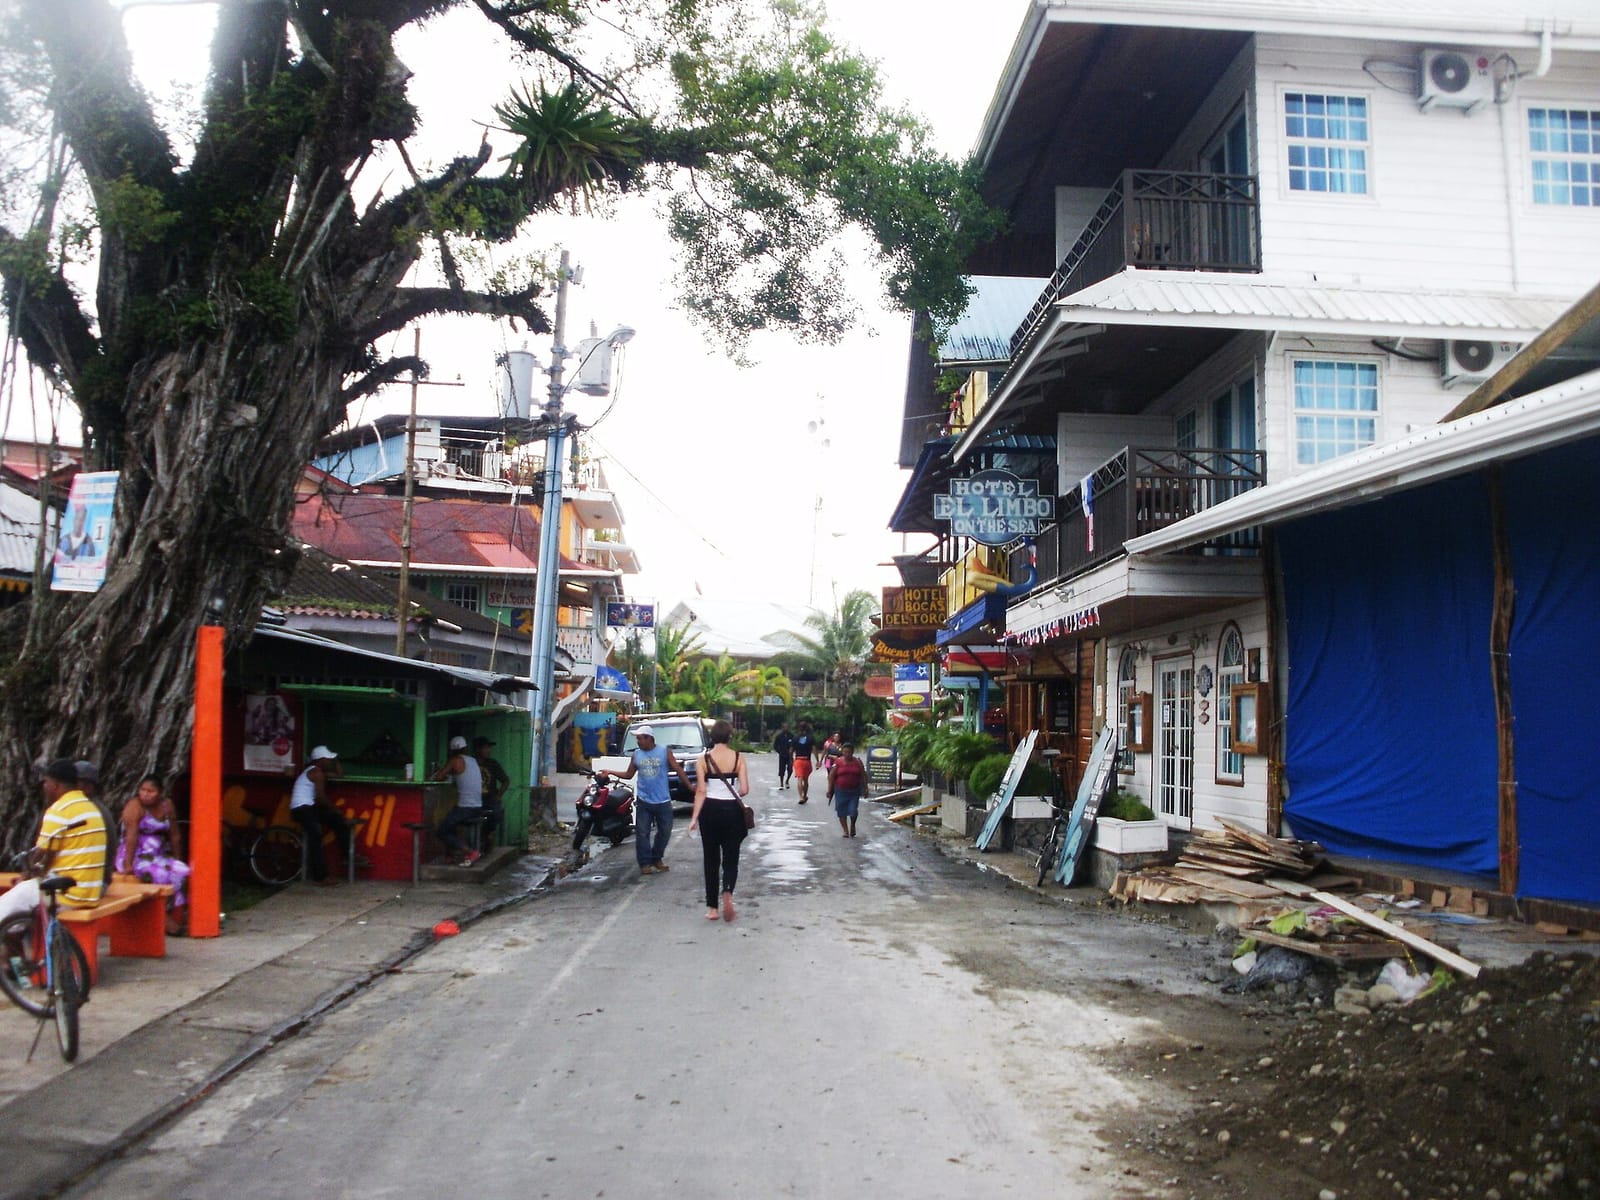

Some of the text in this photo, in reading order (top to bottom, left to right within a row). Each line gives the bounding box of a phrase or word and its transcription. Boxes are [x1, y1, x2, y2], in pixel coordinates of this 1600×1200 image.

[955, 480, 1034, 497] HOTEL
[938, 496, 1050, 518] EL LIMBO
[954, 518, 1037, 534] ON THE SEA
[904, 588, 945, 601] HOTEL
[904, 601, 945, 612] BOCAS
[885, 613, 909, 625] DEL
[875, 639, 910, 658] Buena
